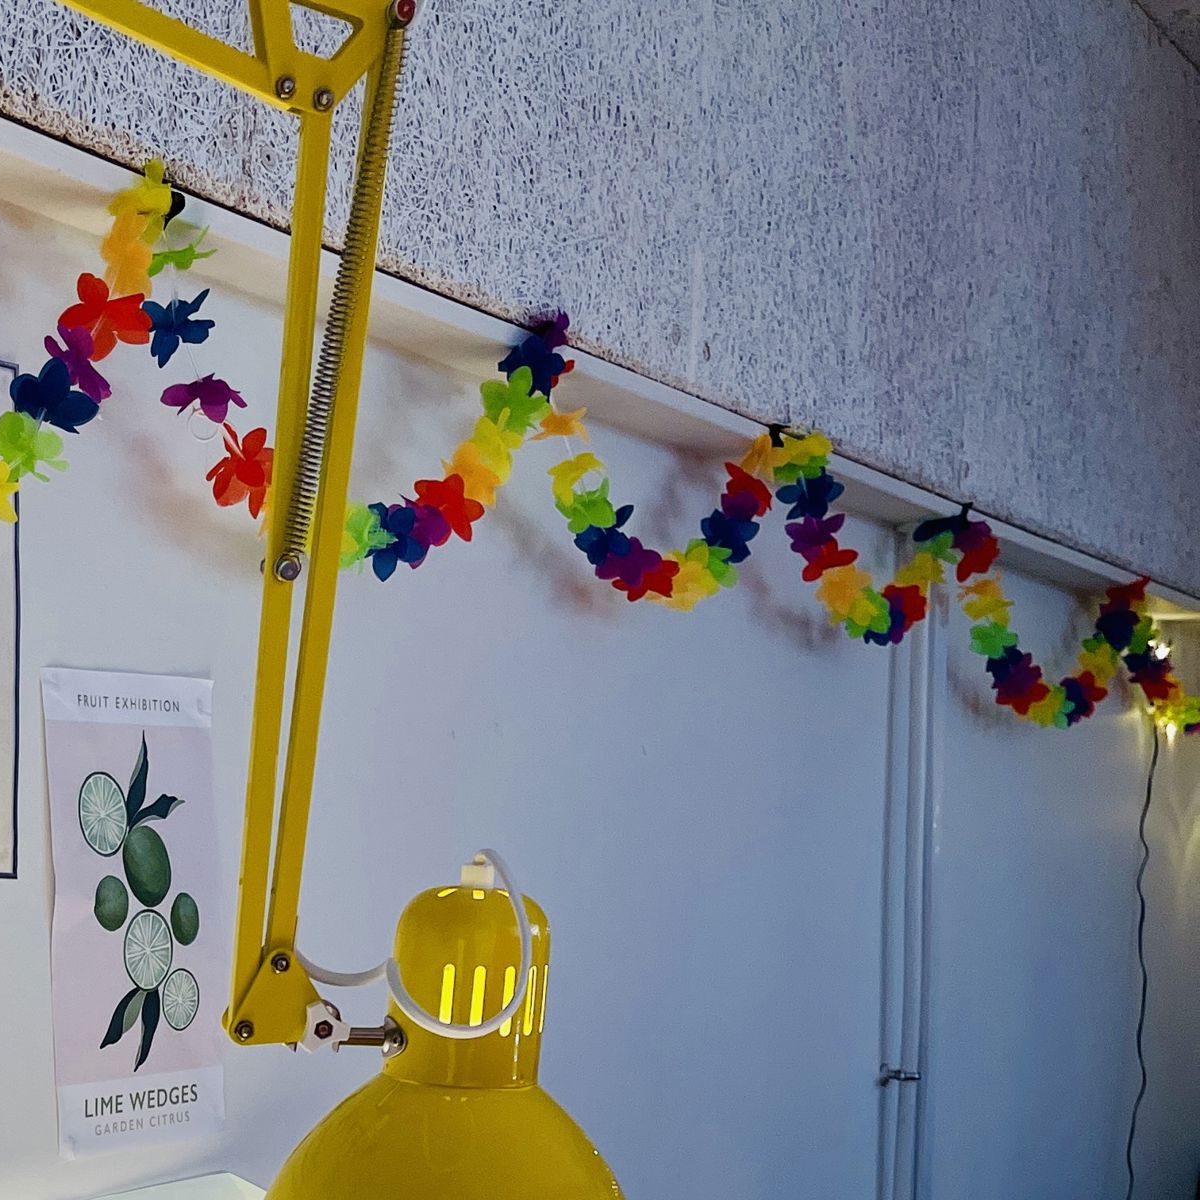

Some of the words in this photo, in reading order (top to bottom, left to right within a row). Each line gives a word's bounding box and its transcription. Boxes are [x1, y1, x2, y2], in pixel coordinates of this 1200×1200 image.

[77, 694, 109, 709] FRUIT
[115, 696, 180, 713] EXHIBITION
[84, 1094, 124, 1118] LIME
[129, 1083, 198, 1111] WEDGES
[94, 1118, 144, 1136] GARDEN
[149, 1110, 191, 1128] CITRUS
